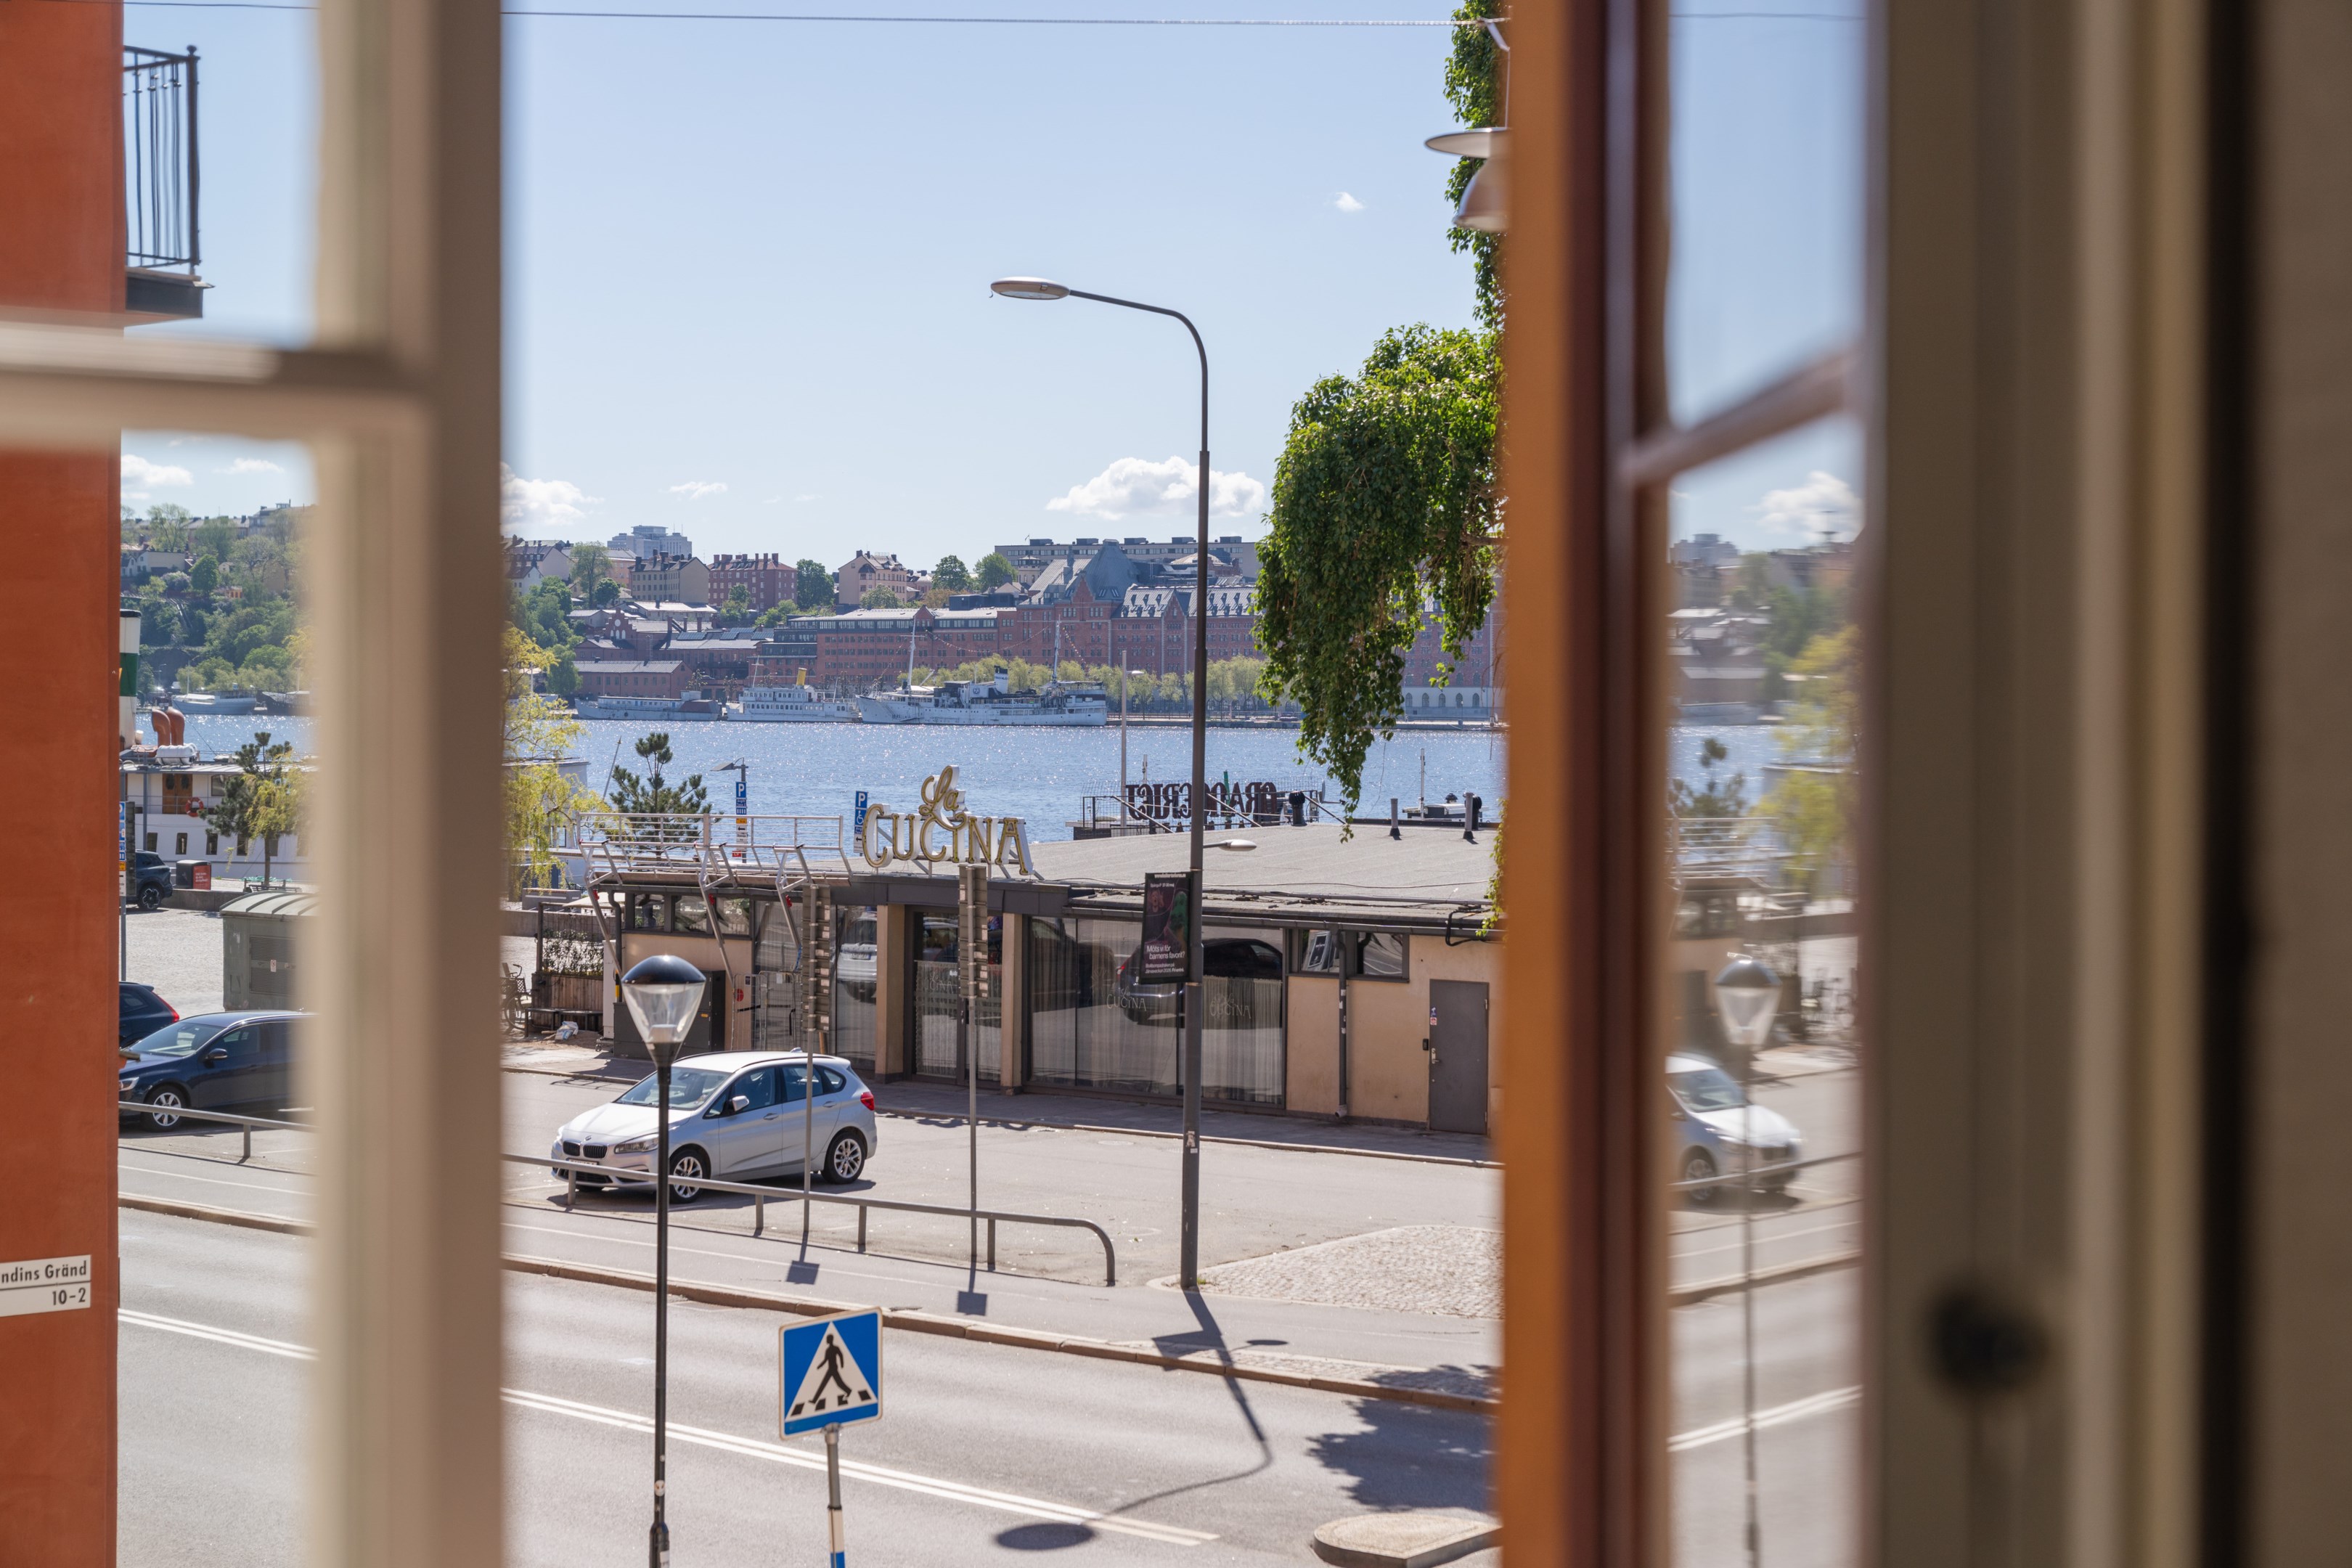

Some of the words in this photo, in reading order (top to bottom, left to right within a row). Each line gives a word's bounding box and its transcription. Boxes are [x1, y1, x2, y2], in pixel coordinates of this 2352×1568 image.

[738, 783, 745, 797] P
[918, 765, 967, 829] La
[858, 793, 866, 807] P
[862, 803, 1034, 875] CUCINA
[1107, 994, 1147, 1011] CUCINA
[1209, 1000, 1251, 1019] CUCINA
[1, 1266, 40, 1284] ndins
[44, 1259, 87, 1280] Gränd
[52, 1287, 86, 1306] 10-2
